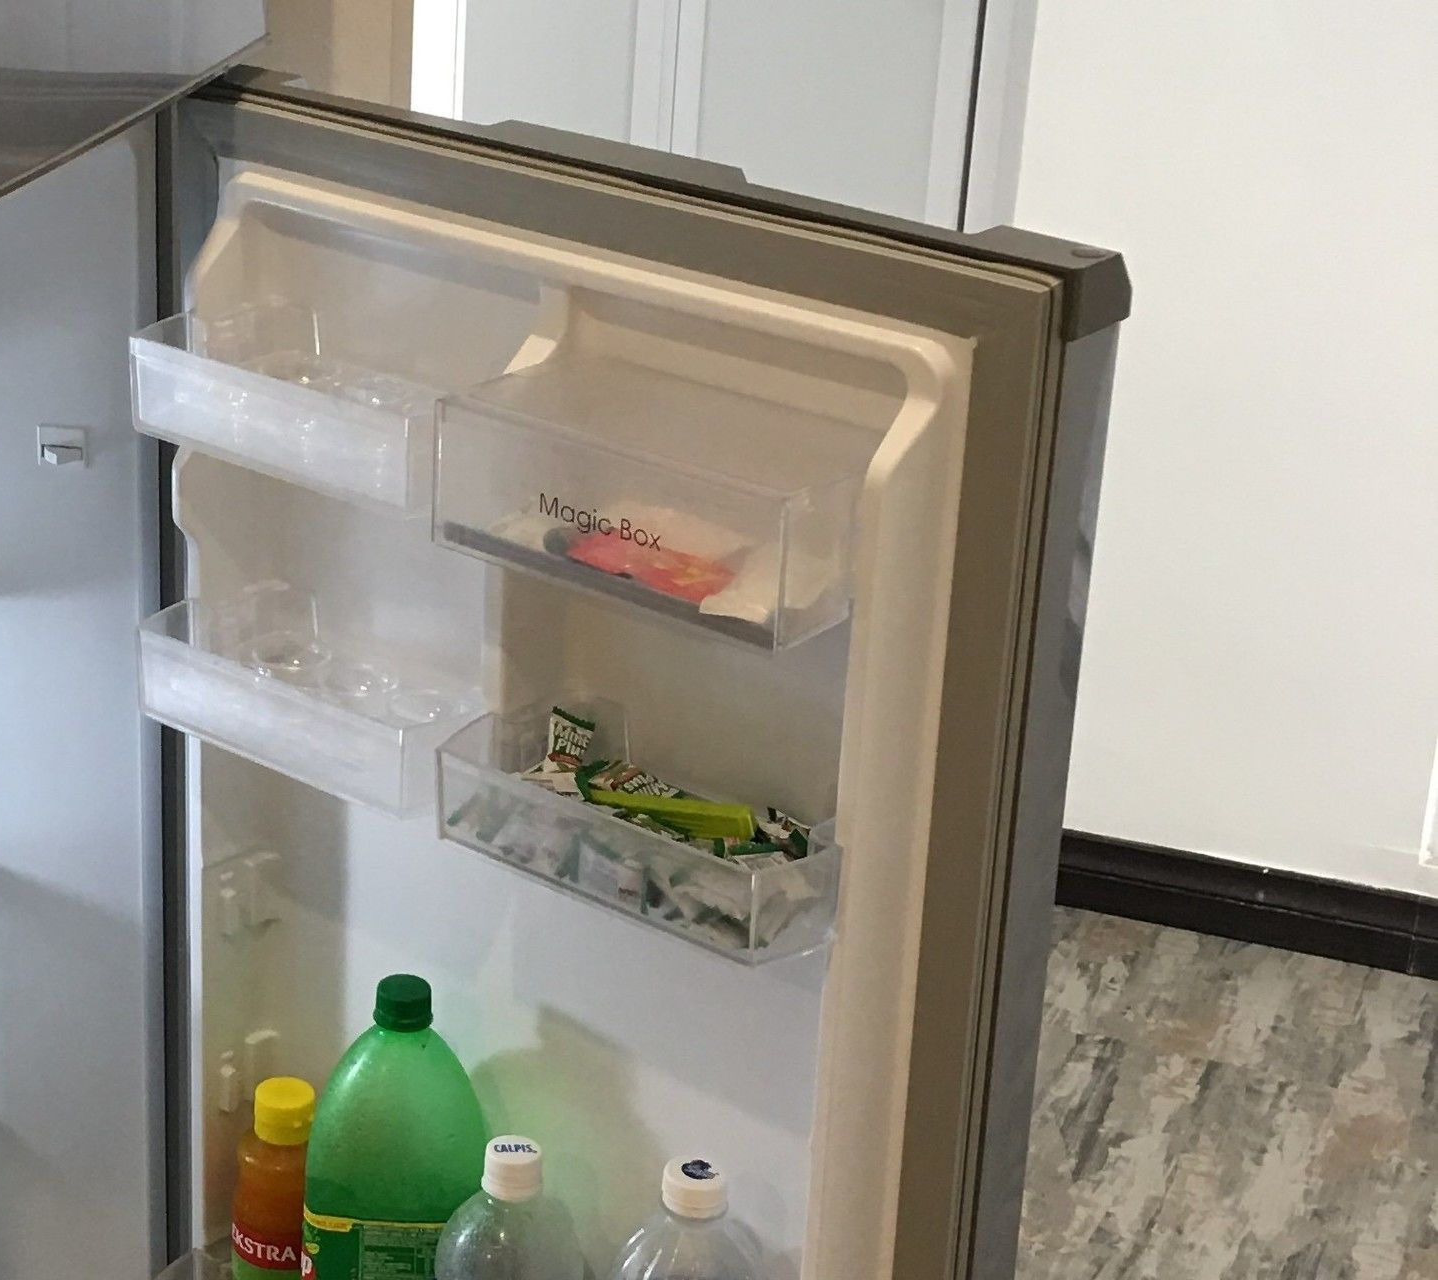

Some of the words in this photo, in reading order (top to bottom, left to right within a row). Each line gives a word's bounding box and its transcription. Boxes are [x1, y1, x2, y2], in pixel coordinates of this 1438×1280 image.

[538, 492, 613, 535] Magic
[619, 518, 661, 552] Box
[493, 1143, 532, 1153] CALPIS
